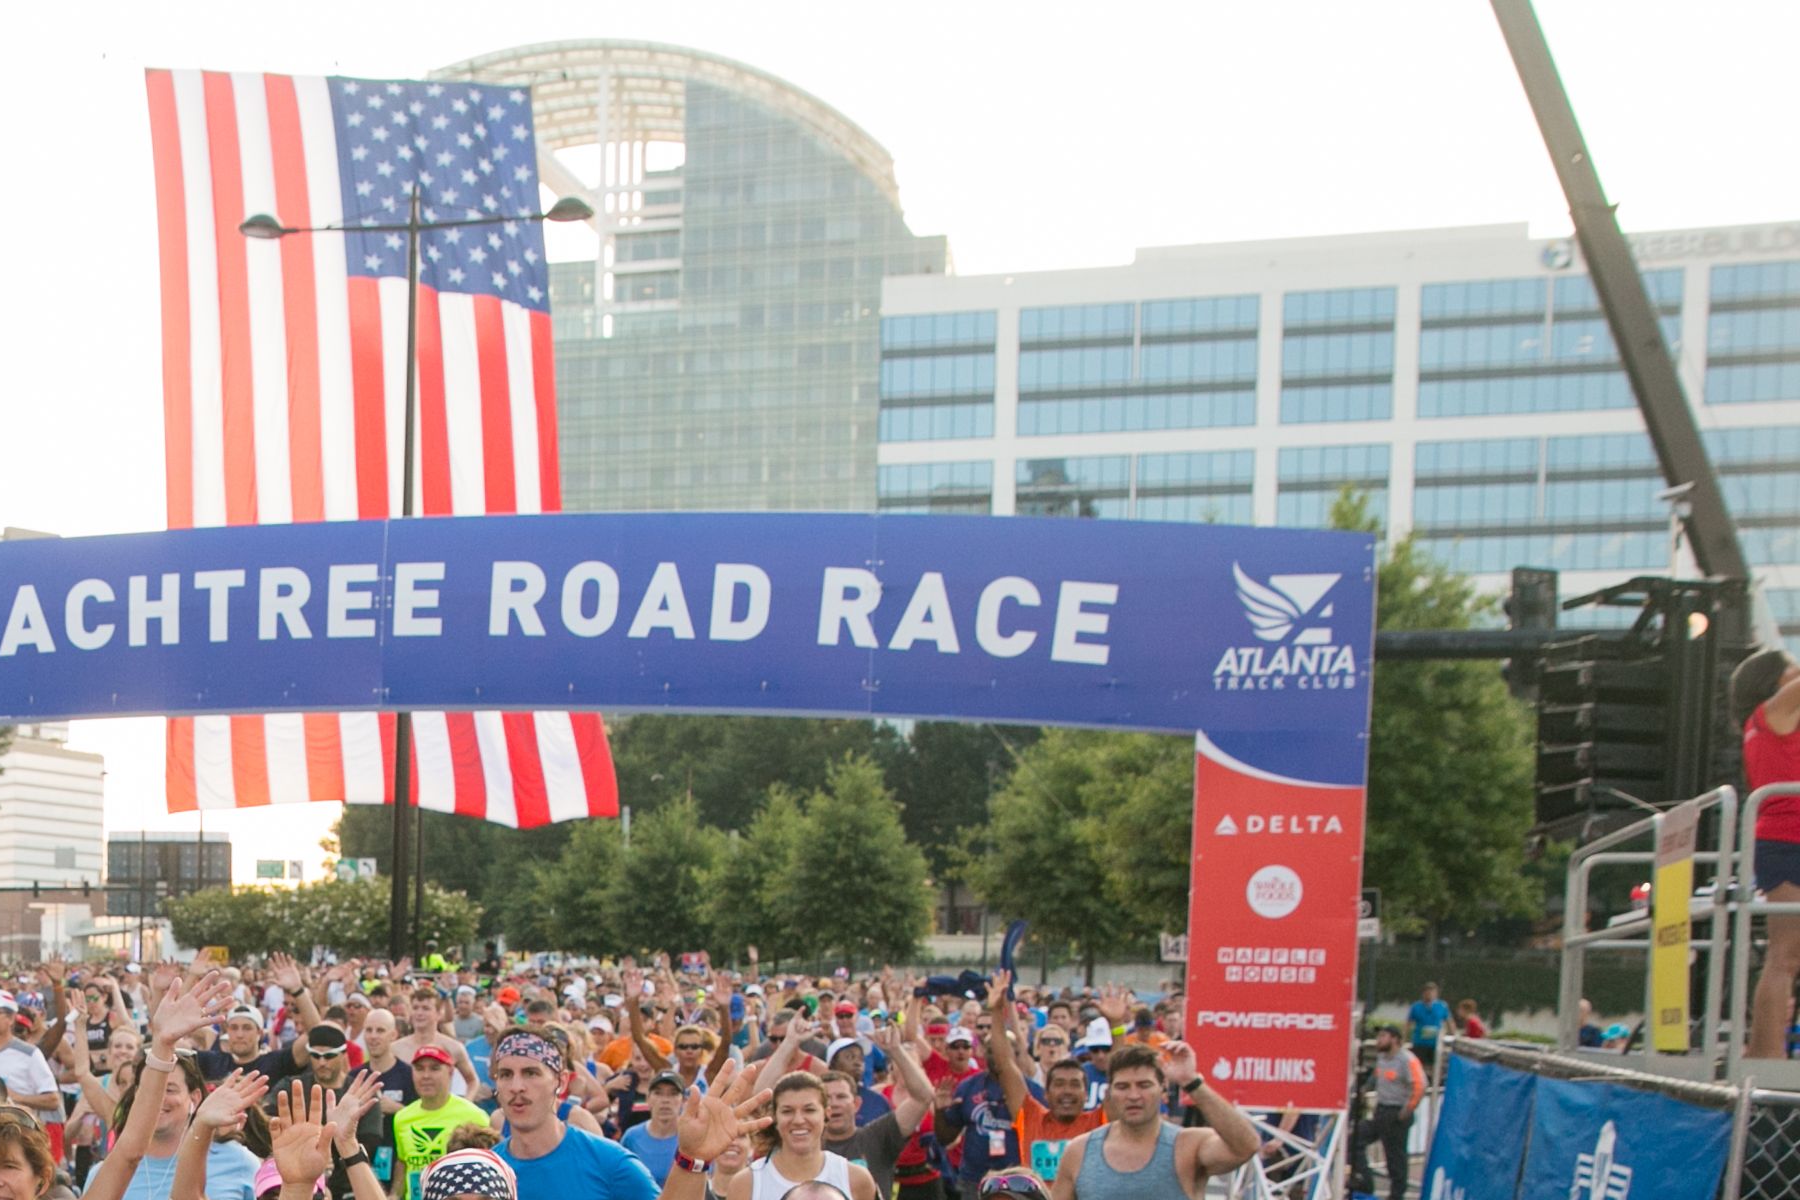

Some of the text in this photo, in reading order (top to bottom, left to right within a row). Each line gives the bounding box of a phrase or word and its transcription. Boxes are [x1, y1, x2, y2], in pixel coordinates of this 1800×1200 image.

[487, 560, 772, 642] ROAD
[817, 566, 1119, 666] RACE
[1212, 643, 1357, 677] ATLANTA
[1213, 674, 1357, 691] TRACK CLUB
[1246, 815, 1343, 834] DELTA
[1219, 948, 1324, 965] WAFFLE
[1227, 966, 1316, 983] HOUSE
[1198, 1011, 1335, 1029] POWERADE
[1234, 1058, 1316, 1082] ATHLINKS
